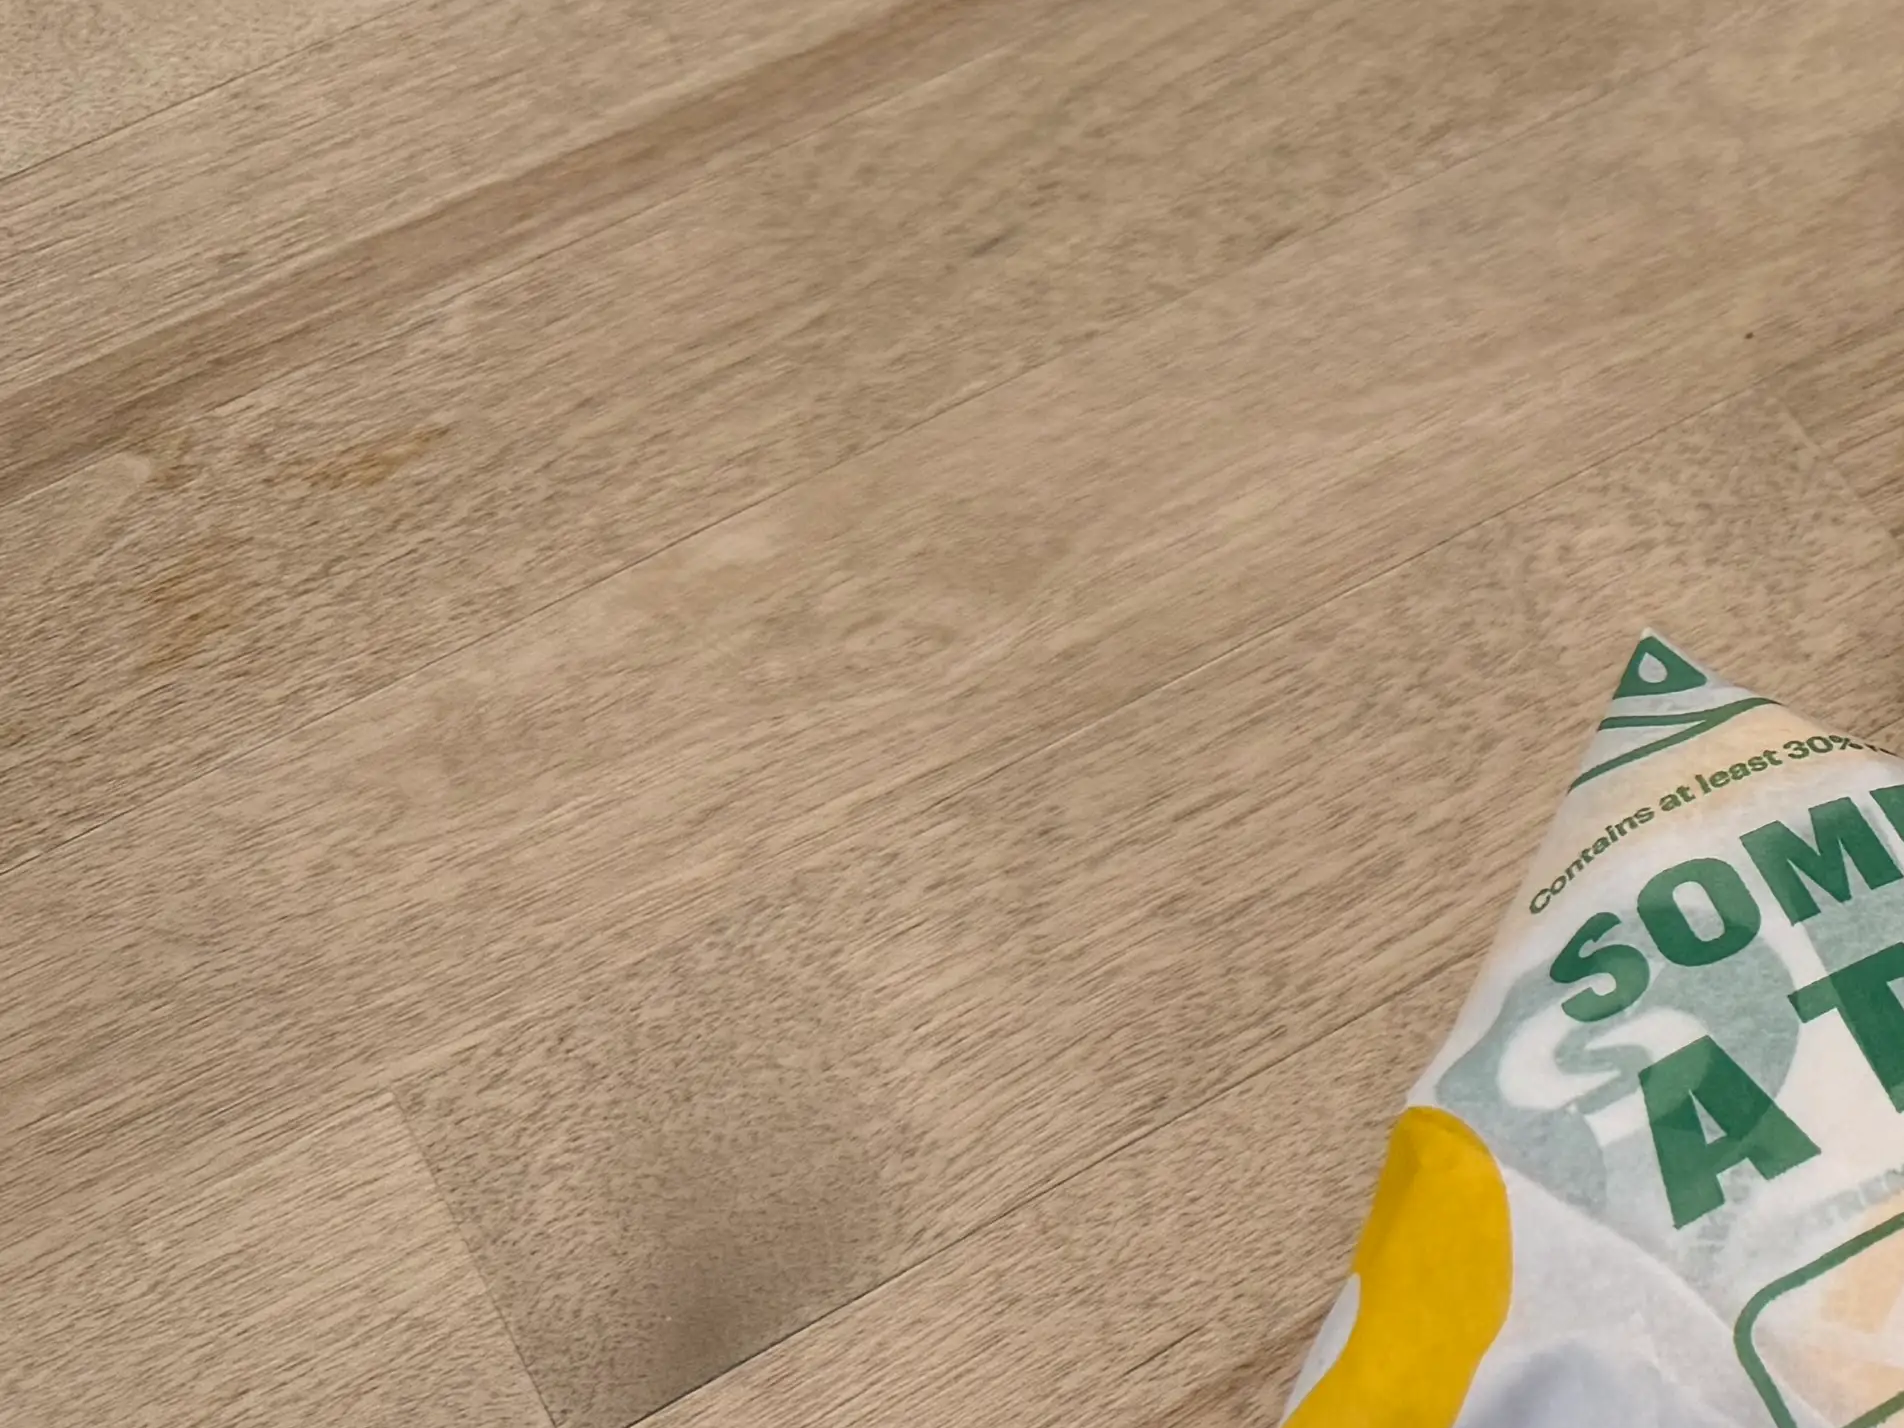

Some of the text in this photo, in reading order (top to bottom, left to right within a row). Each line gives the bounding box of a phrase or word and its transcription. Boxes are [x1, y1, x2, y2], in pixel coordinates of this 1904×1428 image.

[1528, 804, 1655, 915] Contains
[1658, 783, 1698, 813] at
[1693, 748, 1784, 796] least
[1782, 733, 1864, 760] 30%
[1637, 1033, 1822, 1230] A
